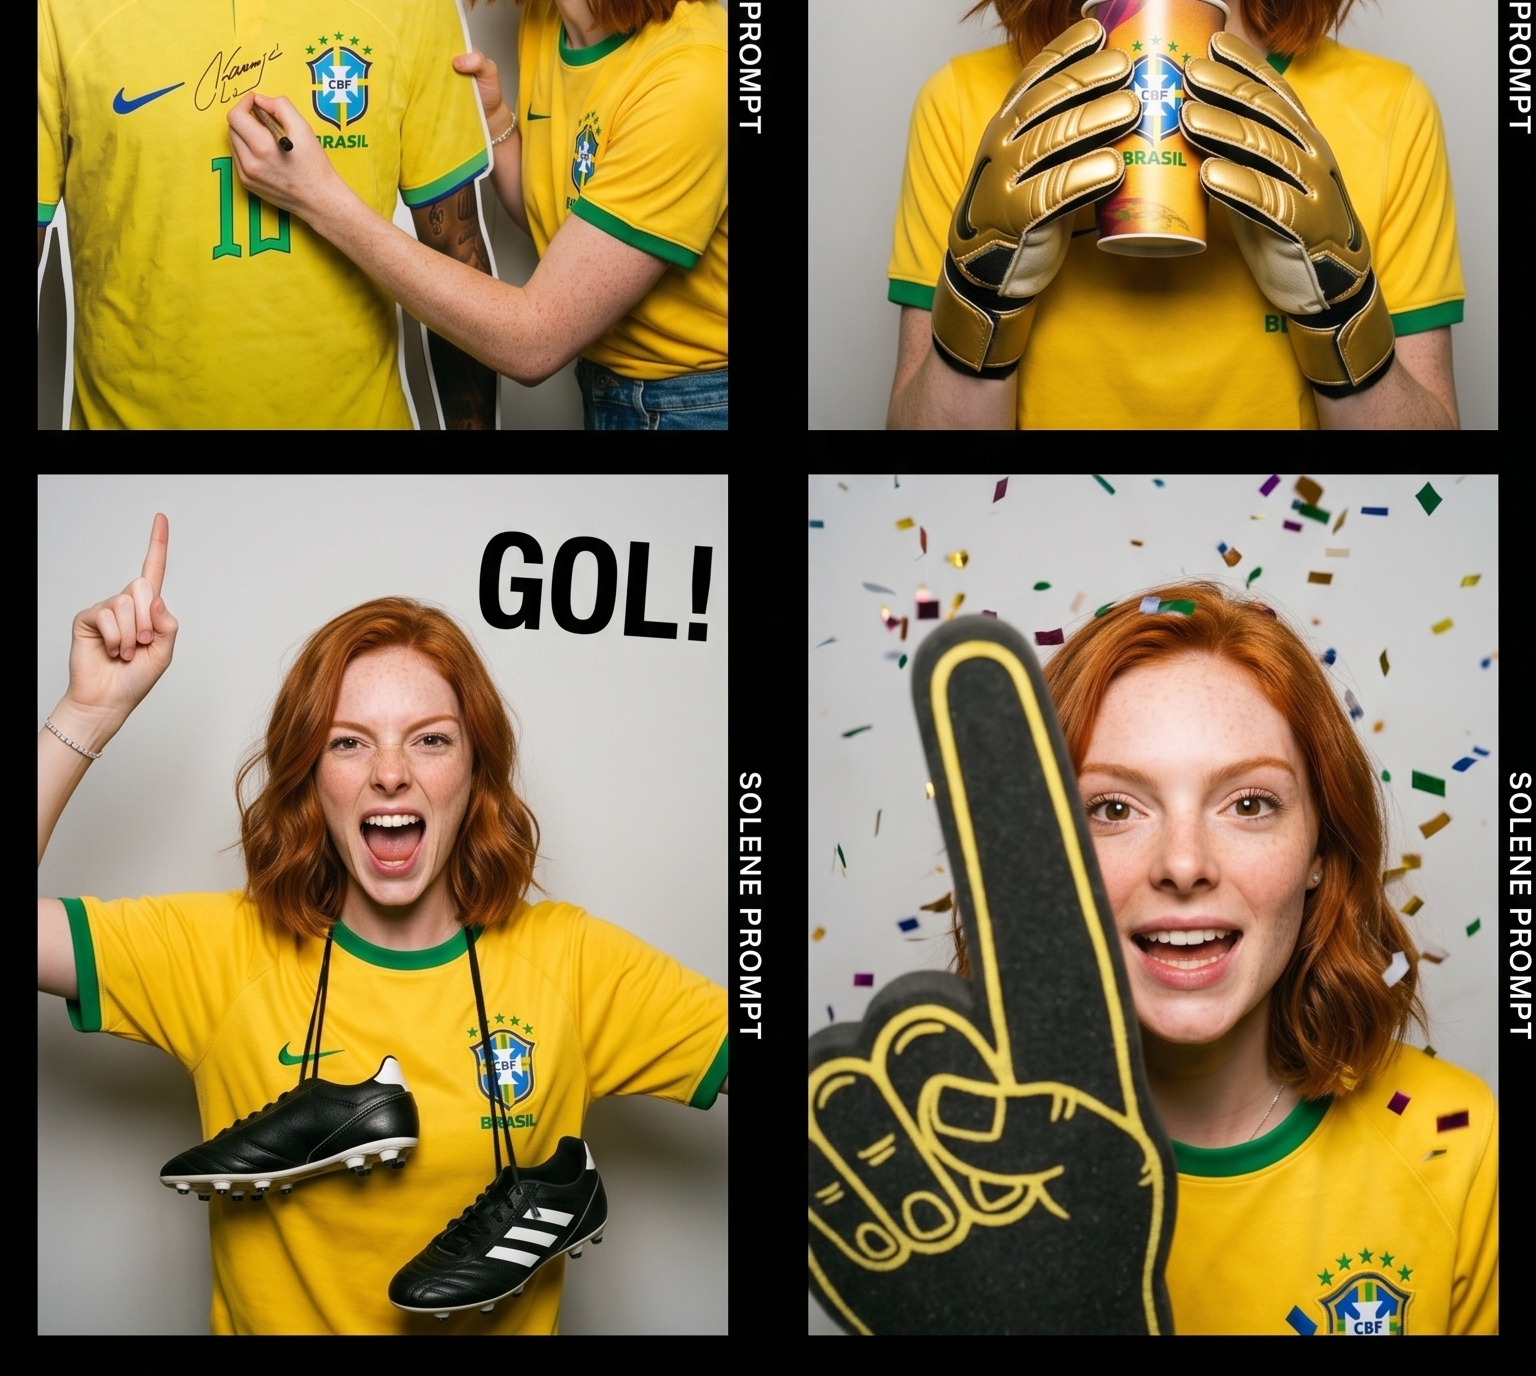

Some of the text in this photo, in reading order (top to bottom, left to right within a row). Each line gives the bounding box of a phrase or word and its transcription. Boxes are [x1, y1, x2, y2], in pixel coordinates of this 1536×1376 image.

[328, 79, 352, 90] CBF
[1141, 89, 1168, 101] CBF
[1123, 150, 1187, 167] BRASIL
[477, 530, 714, 642] GOL!
[1353, 1320, 1383, 1335] CBF
